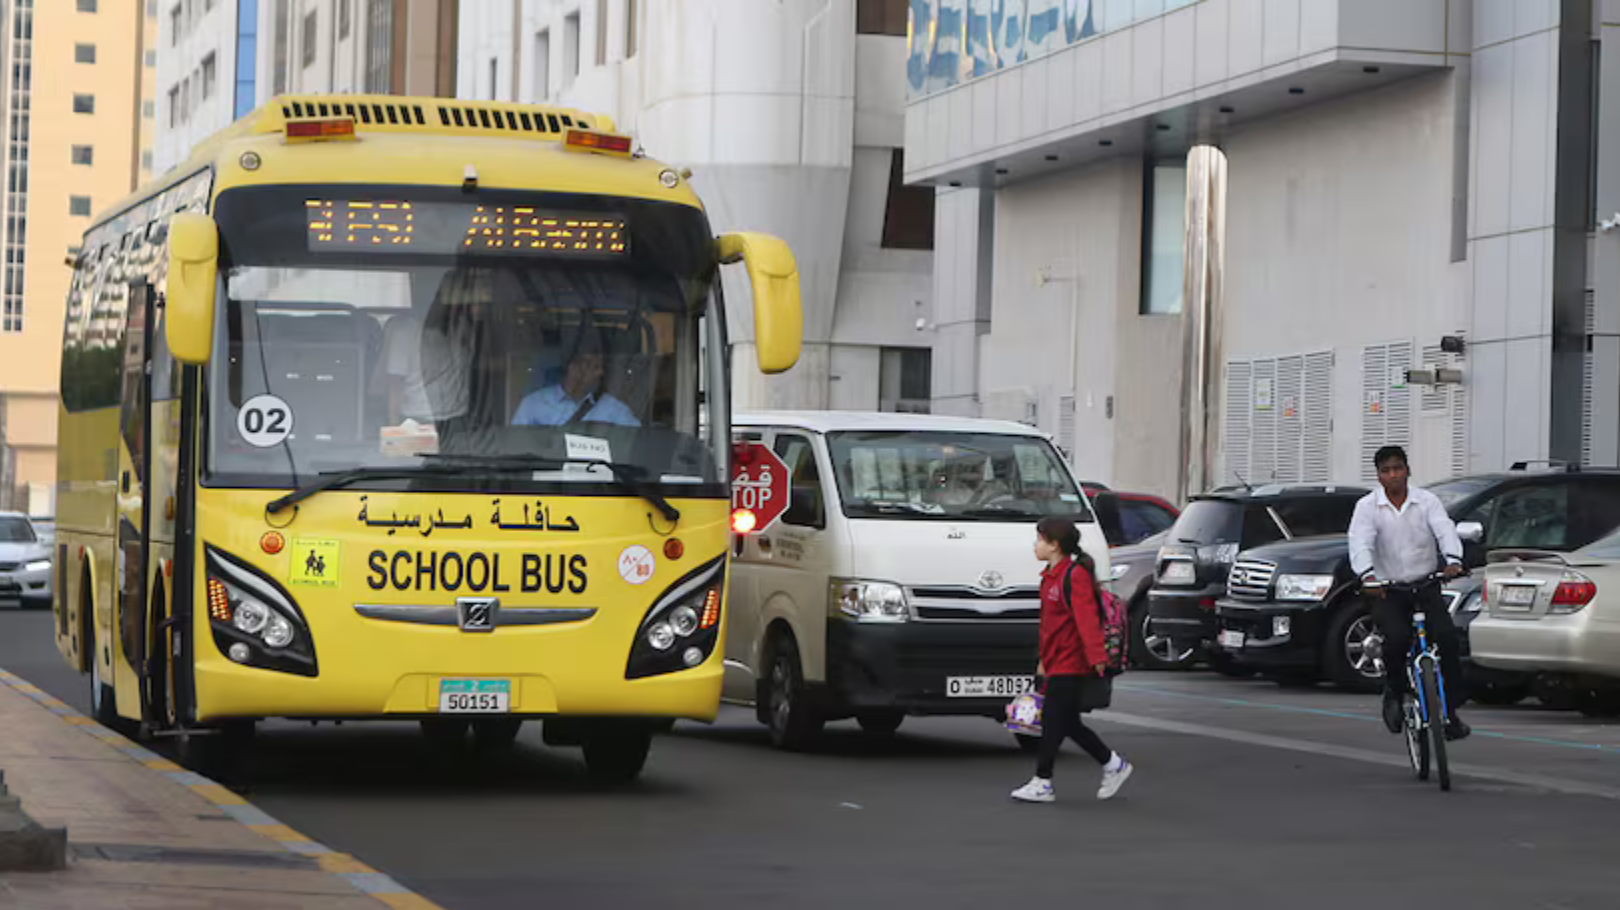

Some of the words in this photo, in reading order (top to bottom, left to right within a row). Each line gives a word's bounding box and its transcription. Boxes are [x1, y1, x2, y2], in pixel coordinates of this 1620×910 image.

[244, 408, 286, 433] 02
[731, 487, 772, 510] TOP
[357, 495, 473, 537] مدرسية
[490, 498, 580, 532] حافلة
[366, 549, 511, 592] SCHOOL
[520, 553, 588, 593] BUS
[636, 564, 650, 576] 80
[448, 694, 499, 710] 50151
